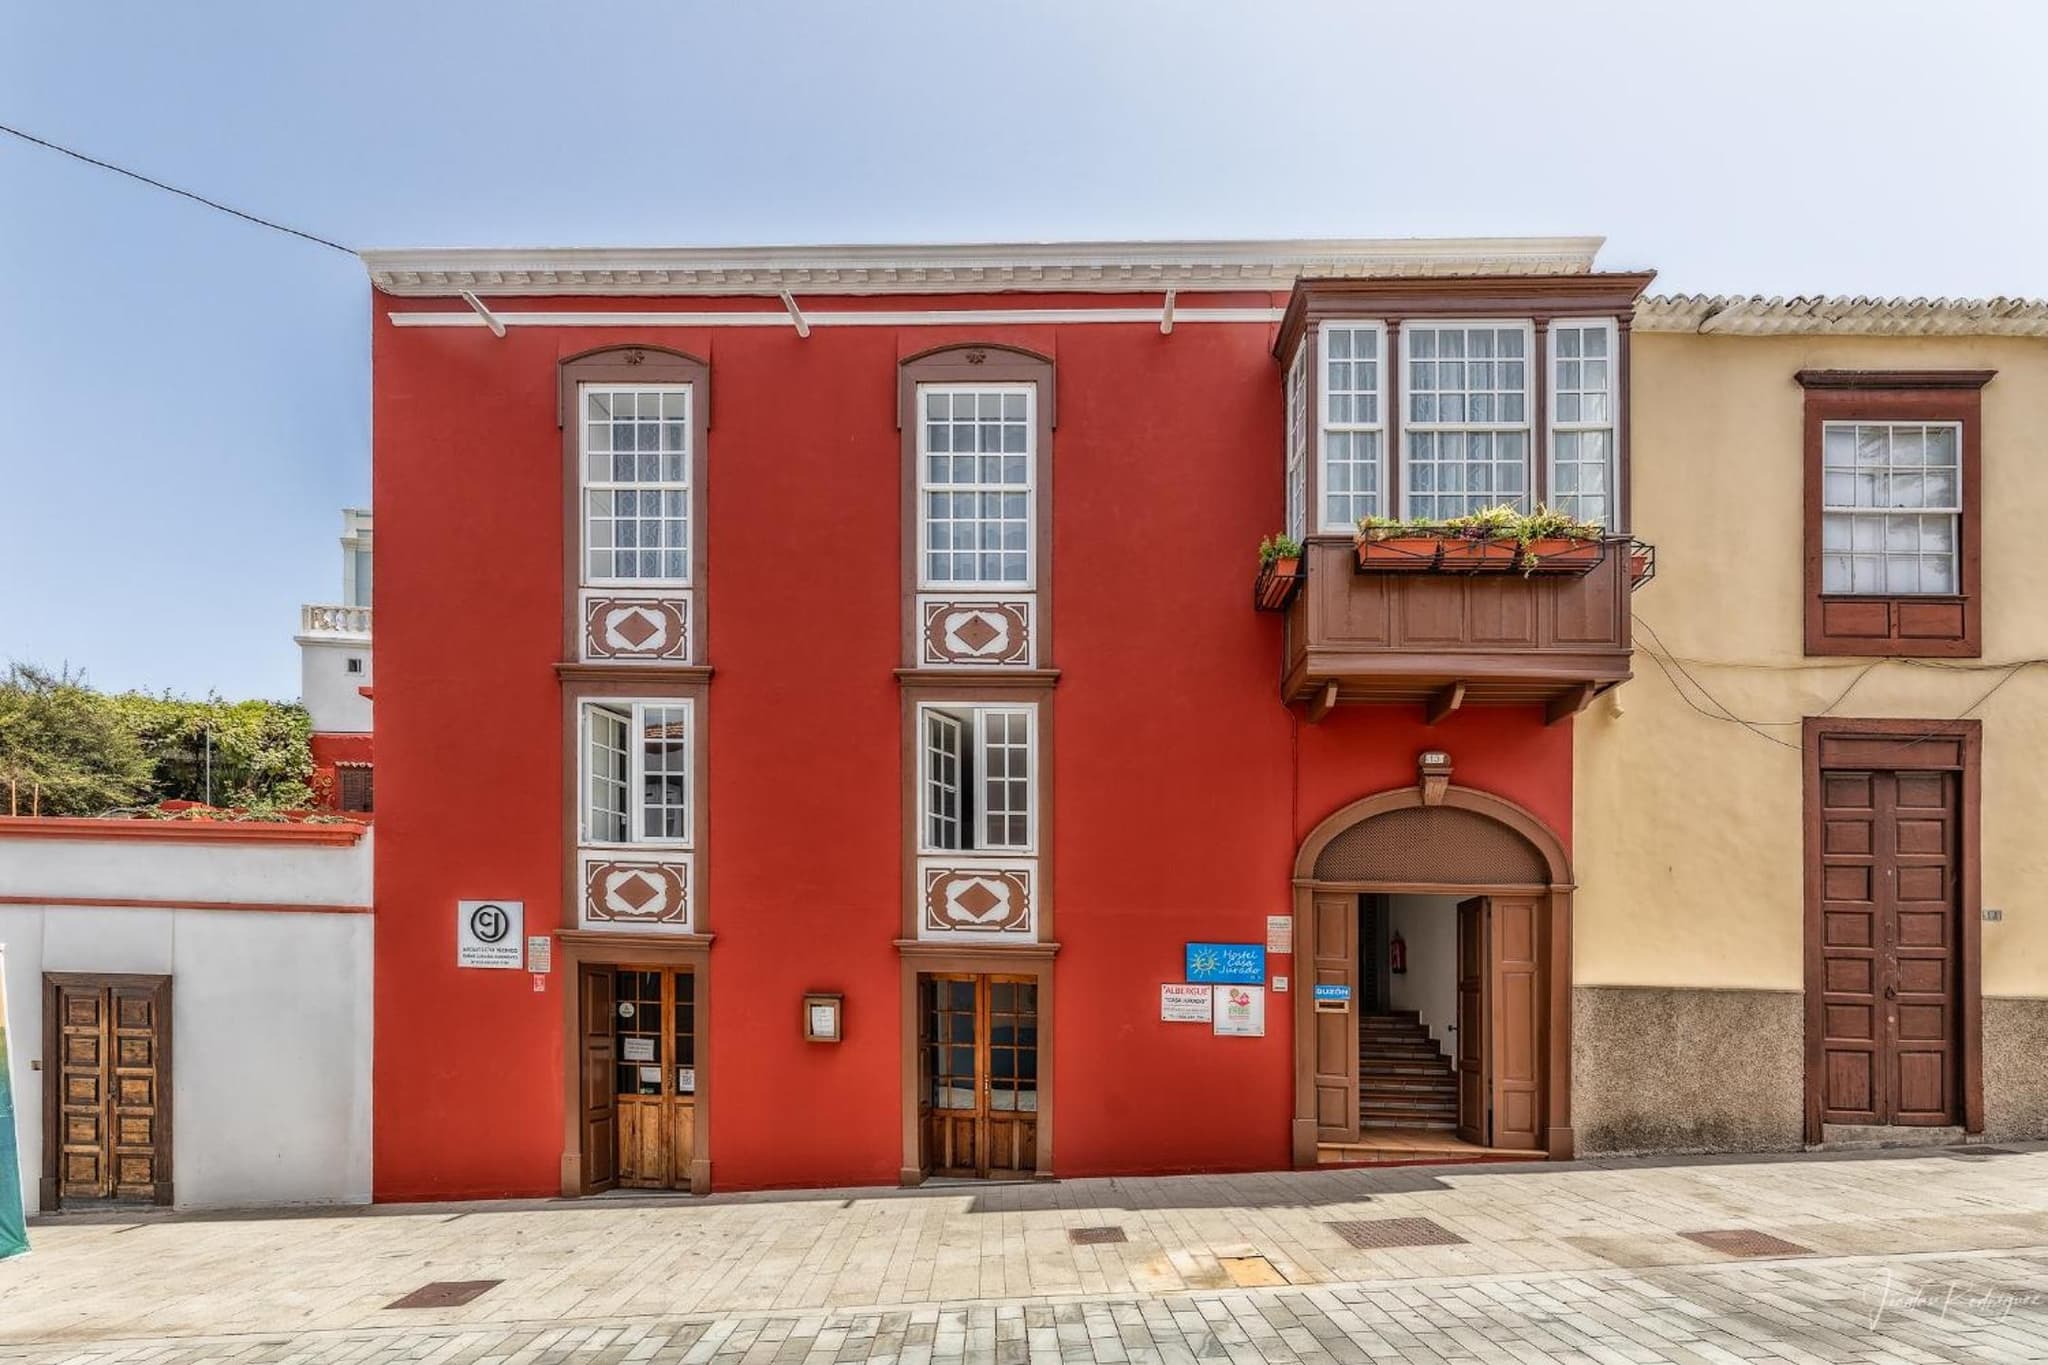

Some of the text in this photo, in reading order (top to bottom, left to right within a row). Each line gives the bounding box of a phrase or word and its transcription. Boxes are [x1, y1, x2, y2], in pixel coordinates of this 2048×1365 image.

[1223, 948, 1258, 961] Hostel
[1227, 959, 1255, 967] Casa
[1218, 965, 1261, 975] Jurado
